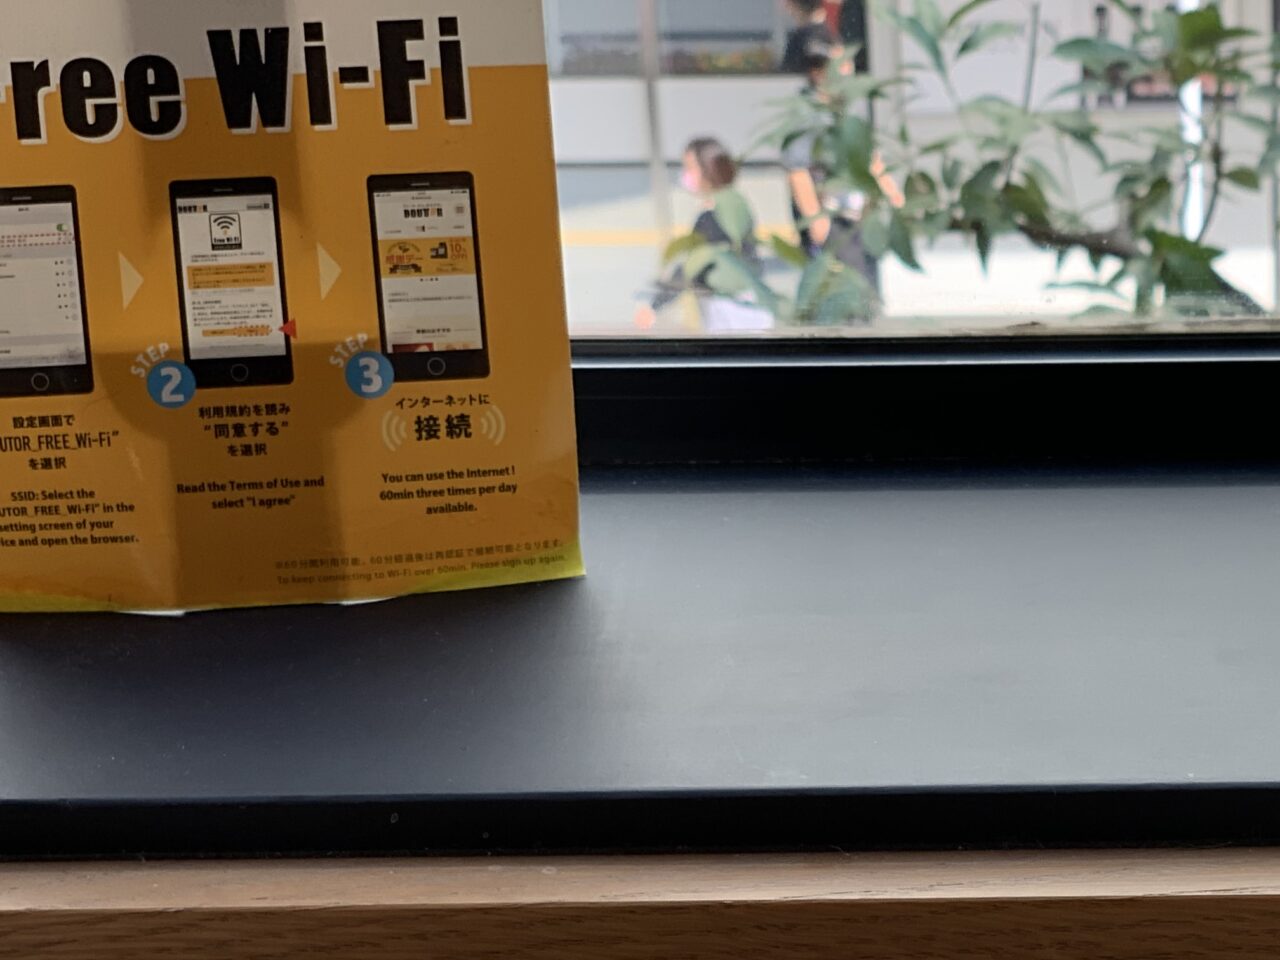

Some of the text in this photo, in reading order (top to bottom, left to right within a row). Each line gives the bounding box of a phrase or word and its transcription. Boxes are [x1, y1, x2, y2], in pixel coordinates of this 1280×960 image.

[10, 16, 469, 139] ree Wi-Fi
[329, 333, 368, 368] STEP
[131, 342, 170, 378] STEP
[358, 357, 383, 393] 3
[160, 366, 185, 403] 2
[395, 393, 490, 409] インターネットに
[12, 414, 75, 429] 設定画面で
[414, 413, 472, 441] 接続
[227, 443, 267, 457] を選択
[28, 457, 67, 470] を選択
[381, 473, 403, 483] You
[405, 473, 424, 482] can
[426, 471, 444, 480] use
[446, 469, 464, 479] the
[176, 475, 325, 493] Read the Terms of Use and
[379, 482, 517, 500] 60min three times per day
[41, 490, 74, 500] Select
[76, 488, 96, 499] the
[103, 503, 113, 513] in
[116, 501, 136, 512] the
[212, 498, 244, 509] select
[39, 521, 73, 531] screen
[75, 519, 86, 529] of
[89, 520, 114, 531] your
[19, 536, 38, 546] and
[41, 537, 68, 548] open
[70, 534, 88, 545] the
